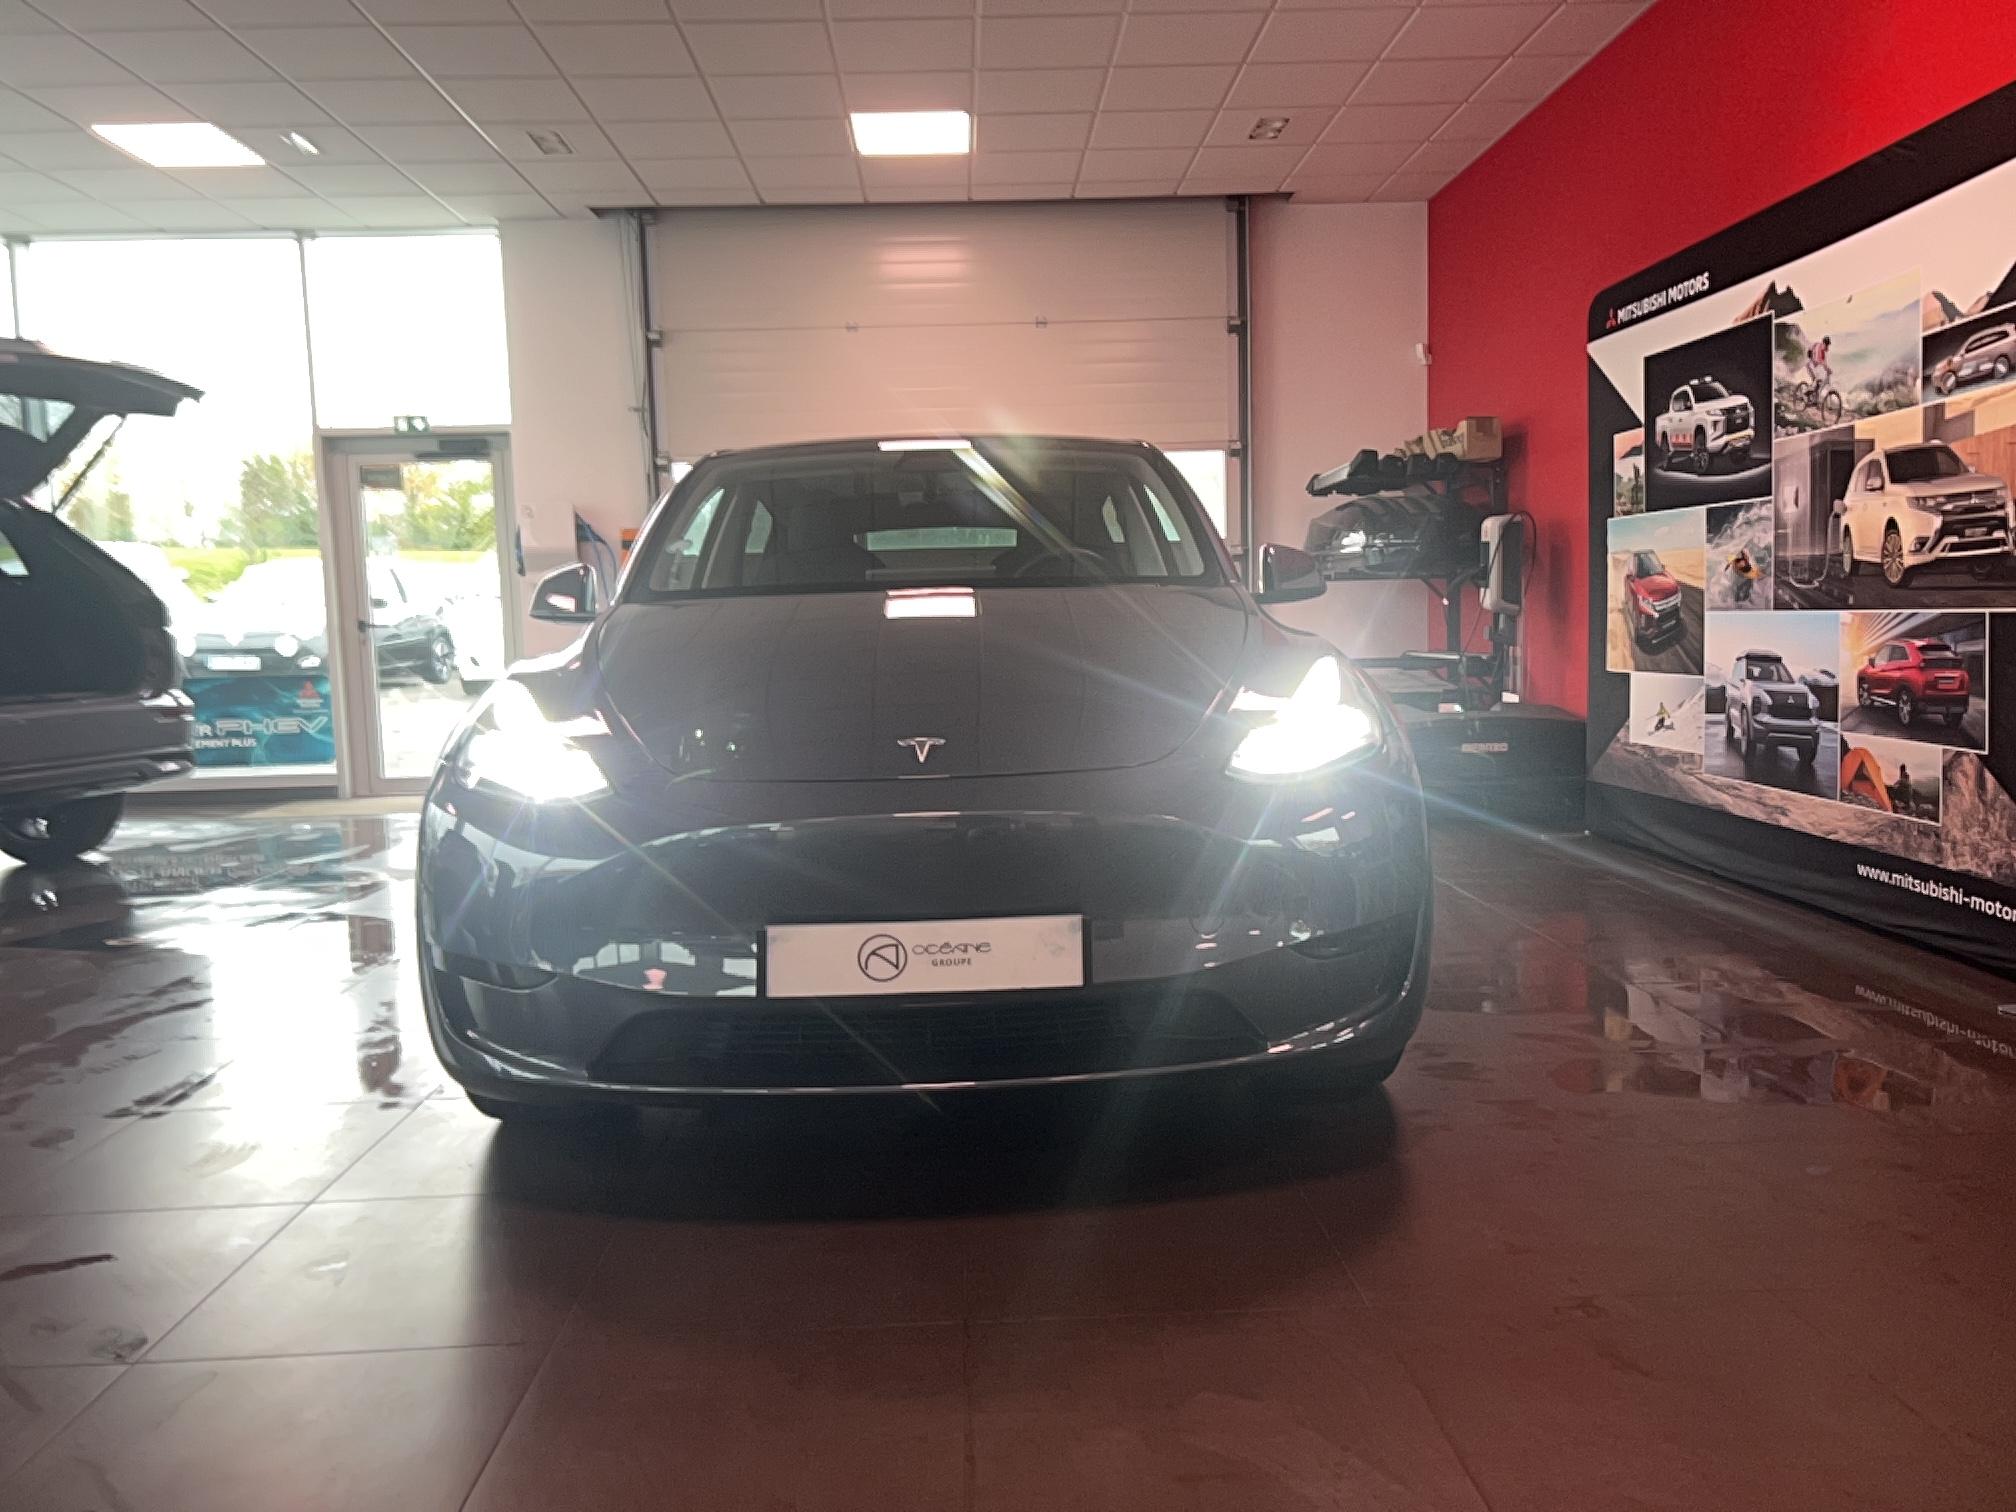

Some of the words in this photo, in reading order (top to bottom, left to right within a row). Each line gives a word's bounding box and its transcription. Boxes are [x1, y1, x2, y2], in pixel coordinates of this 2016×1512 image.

[1617, 291, 1667, 324] MITSUBISHI
[1668, 271, 1709, 304] MOTORS
[216, 716, 328, 735] PHEV
[931, 958, 972, 967] GROUPE
